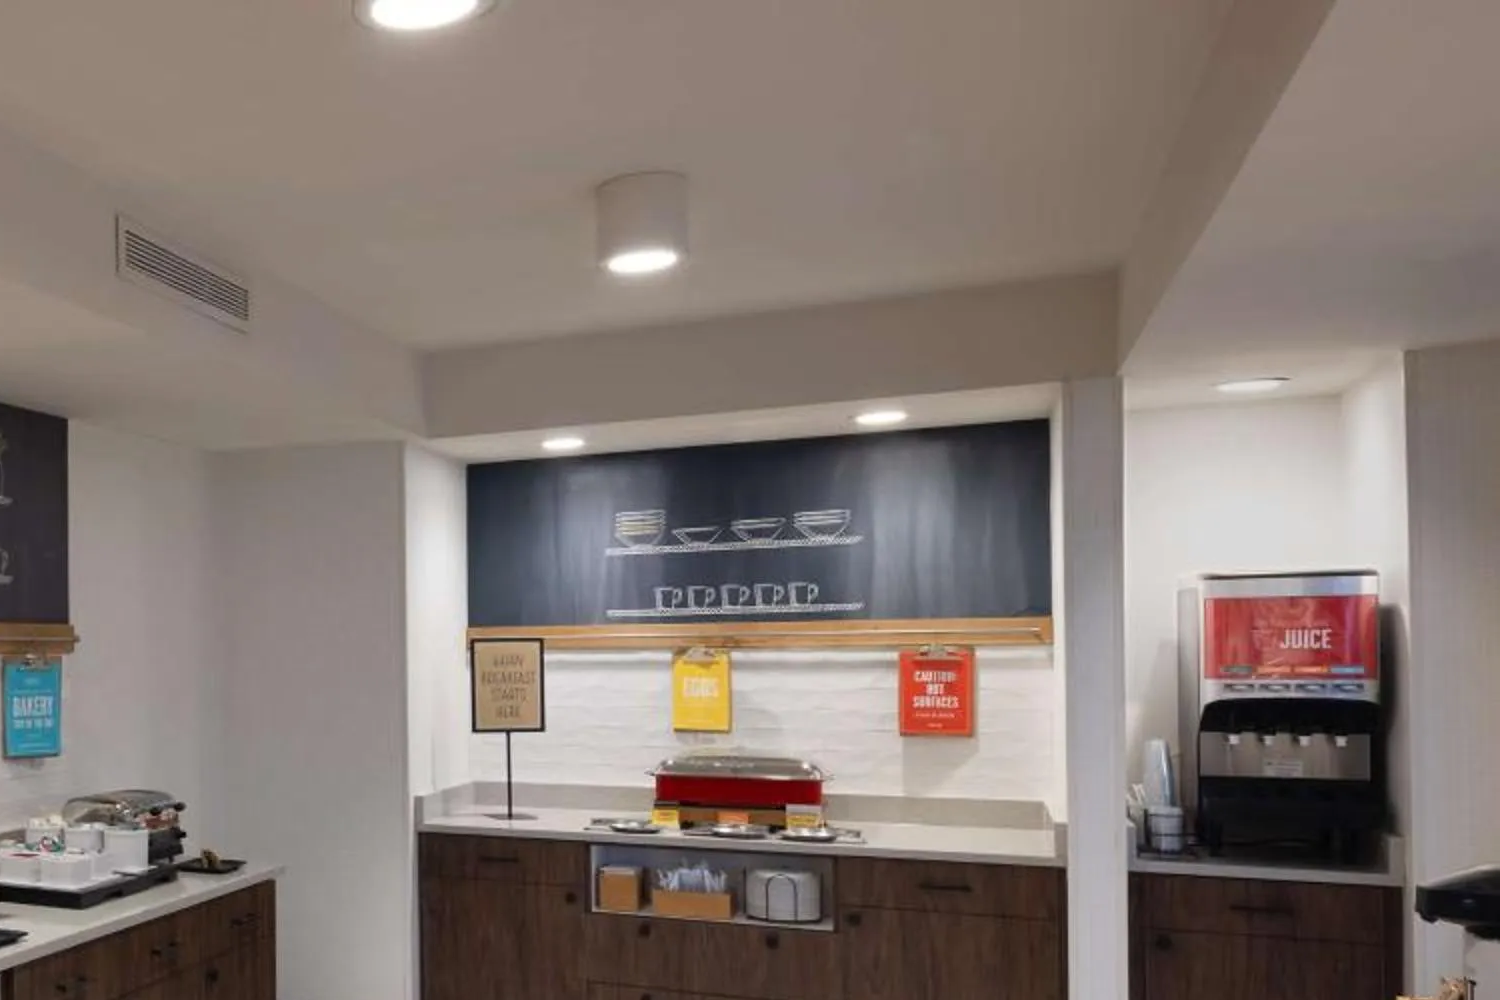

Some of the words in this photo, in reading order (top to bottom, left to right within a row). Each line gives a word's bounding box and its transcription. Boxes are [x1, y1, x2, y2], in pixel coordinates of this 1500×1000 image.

[1280, 628, 1332, 649] JUICE
[926, 683, 945, 694] HOT
[12, 695, 54, 718] BAKERY
[912, 695, 960, 708] SURFACES
